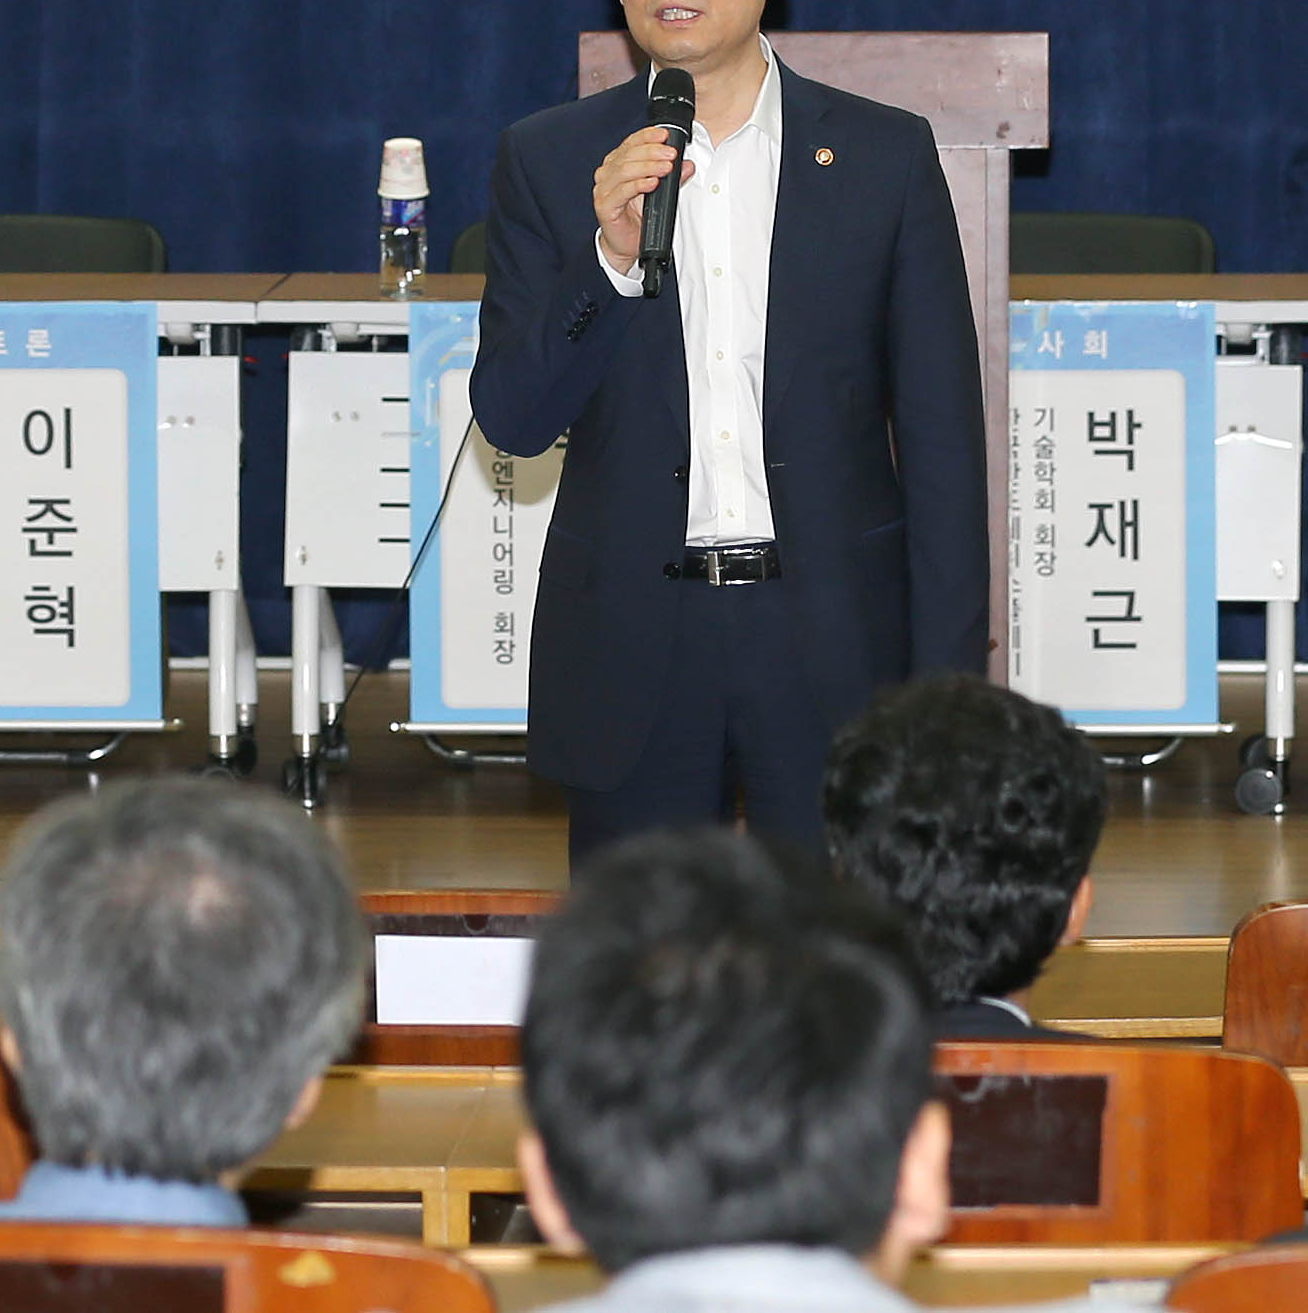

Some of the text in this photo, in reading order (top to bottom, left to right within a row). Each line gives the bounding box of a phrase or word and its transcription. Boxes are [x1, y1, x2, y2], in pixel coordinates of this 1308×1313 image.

[1037, 329, 1109, 360] 사회
[21, 407, 79, 649] 이준혁
[492, 450, 516, 666] 엔지니어링 회장
[1033, 406, 1057, 578] 기술학회 회장
[1084, 408, 1143, 651] 박재근
